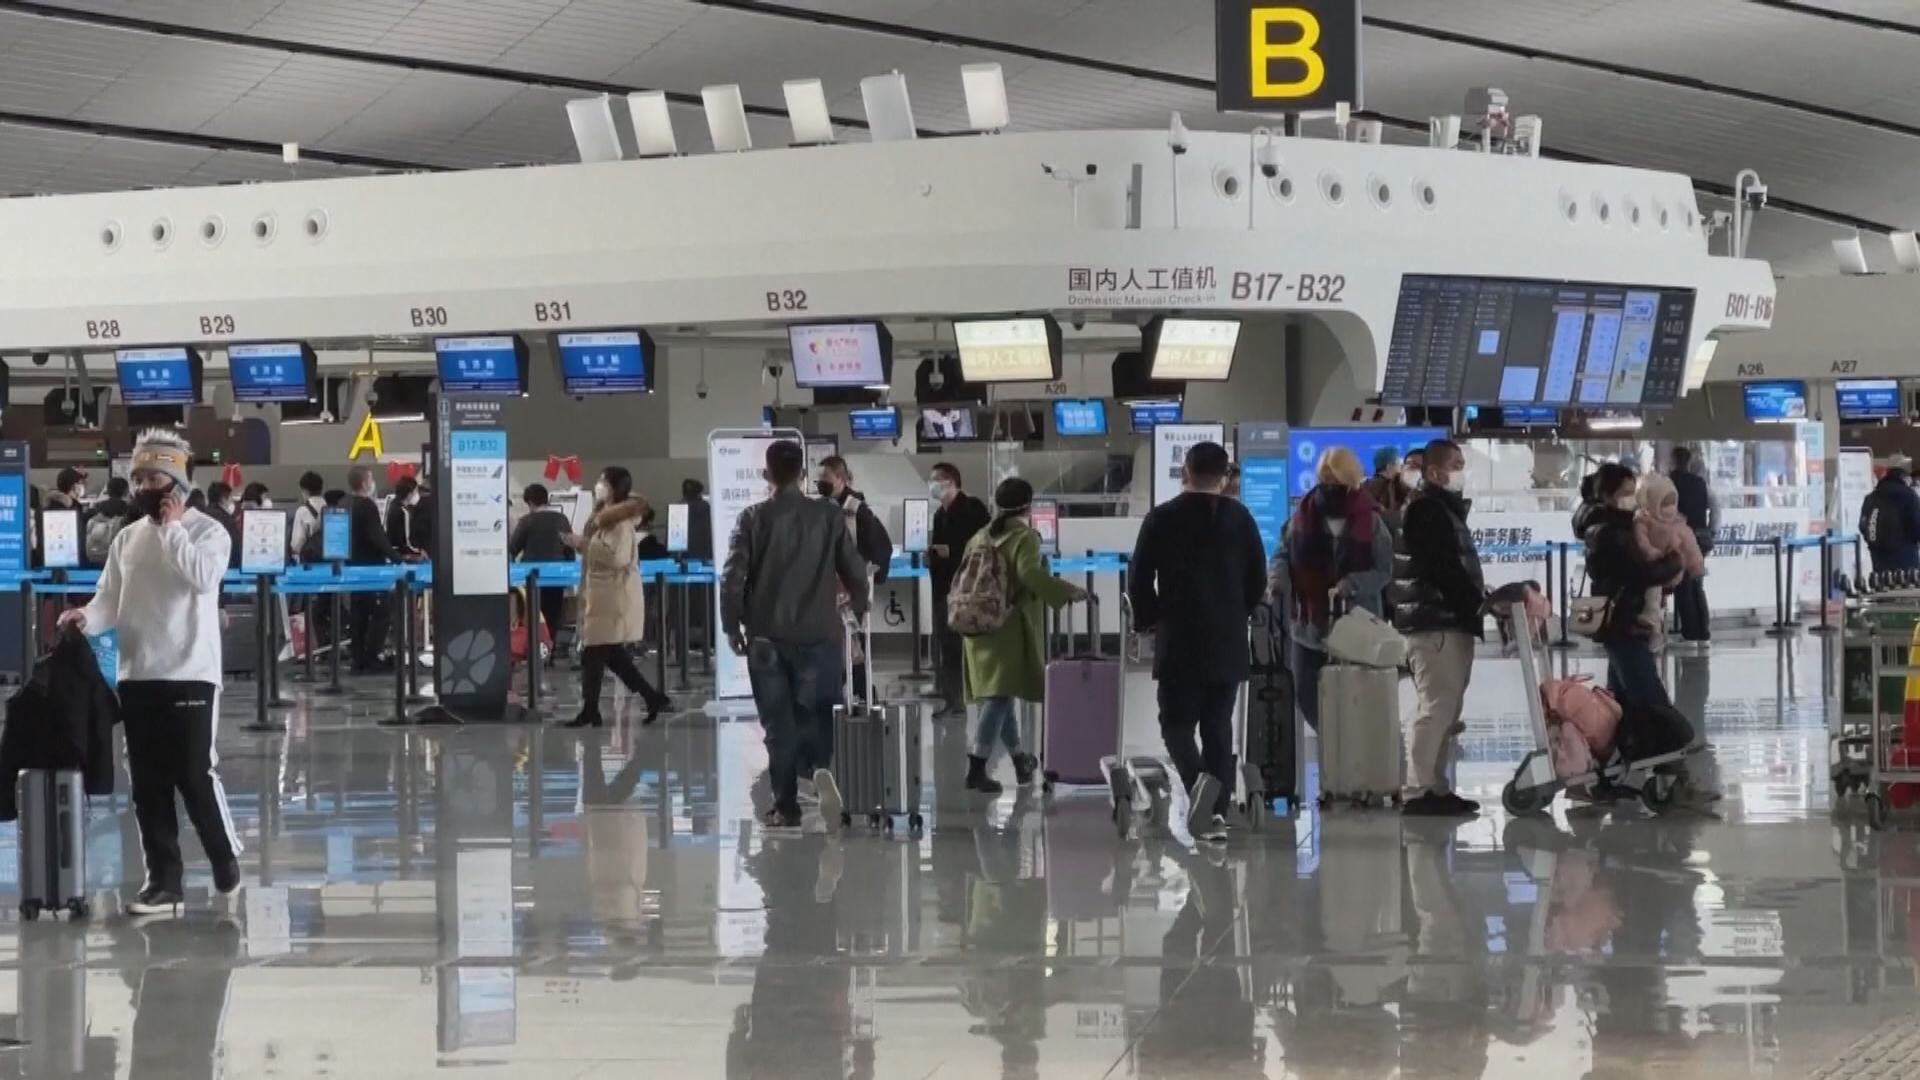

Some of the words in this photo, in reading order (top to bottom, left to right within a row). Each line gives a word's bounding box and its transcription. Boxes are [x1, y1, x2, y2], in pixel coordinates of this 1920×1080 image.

[1251, 8, 1325, 97] B
[1068, 266, 1217, 291] 国内人工值机
[766, 290, 808, 311] B32
[410, 306, 447, 327] B30
[535, 302, 571, 322] B31
[86, 320, 120, 338] B28
[200, 315, 235, 335] B29
[1737, 363, 1764, 376] A26
[1831, 361, 1857, 373] A27
[1045, 382, 1067, 394] A20
[349, 413, 383, 459] A
